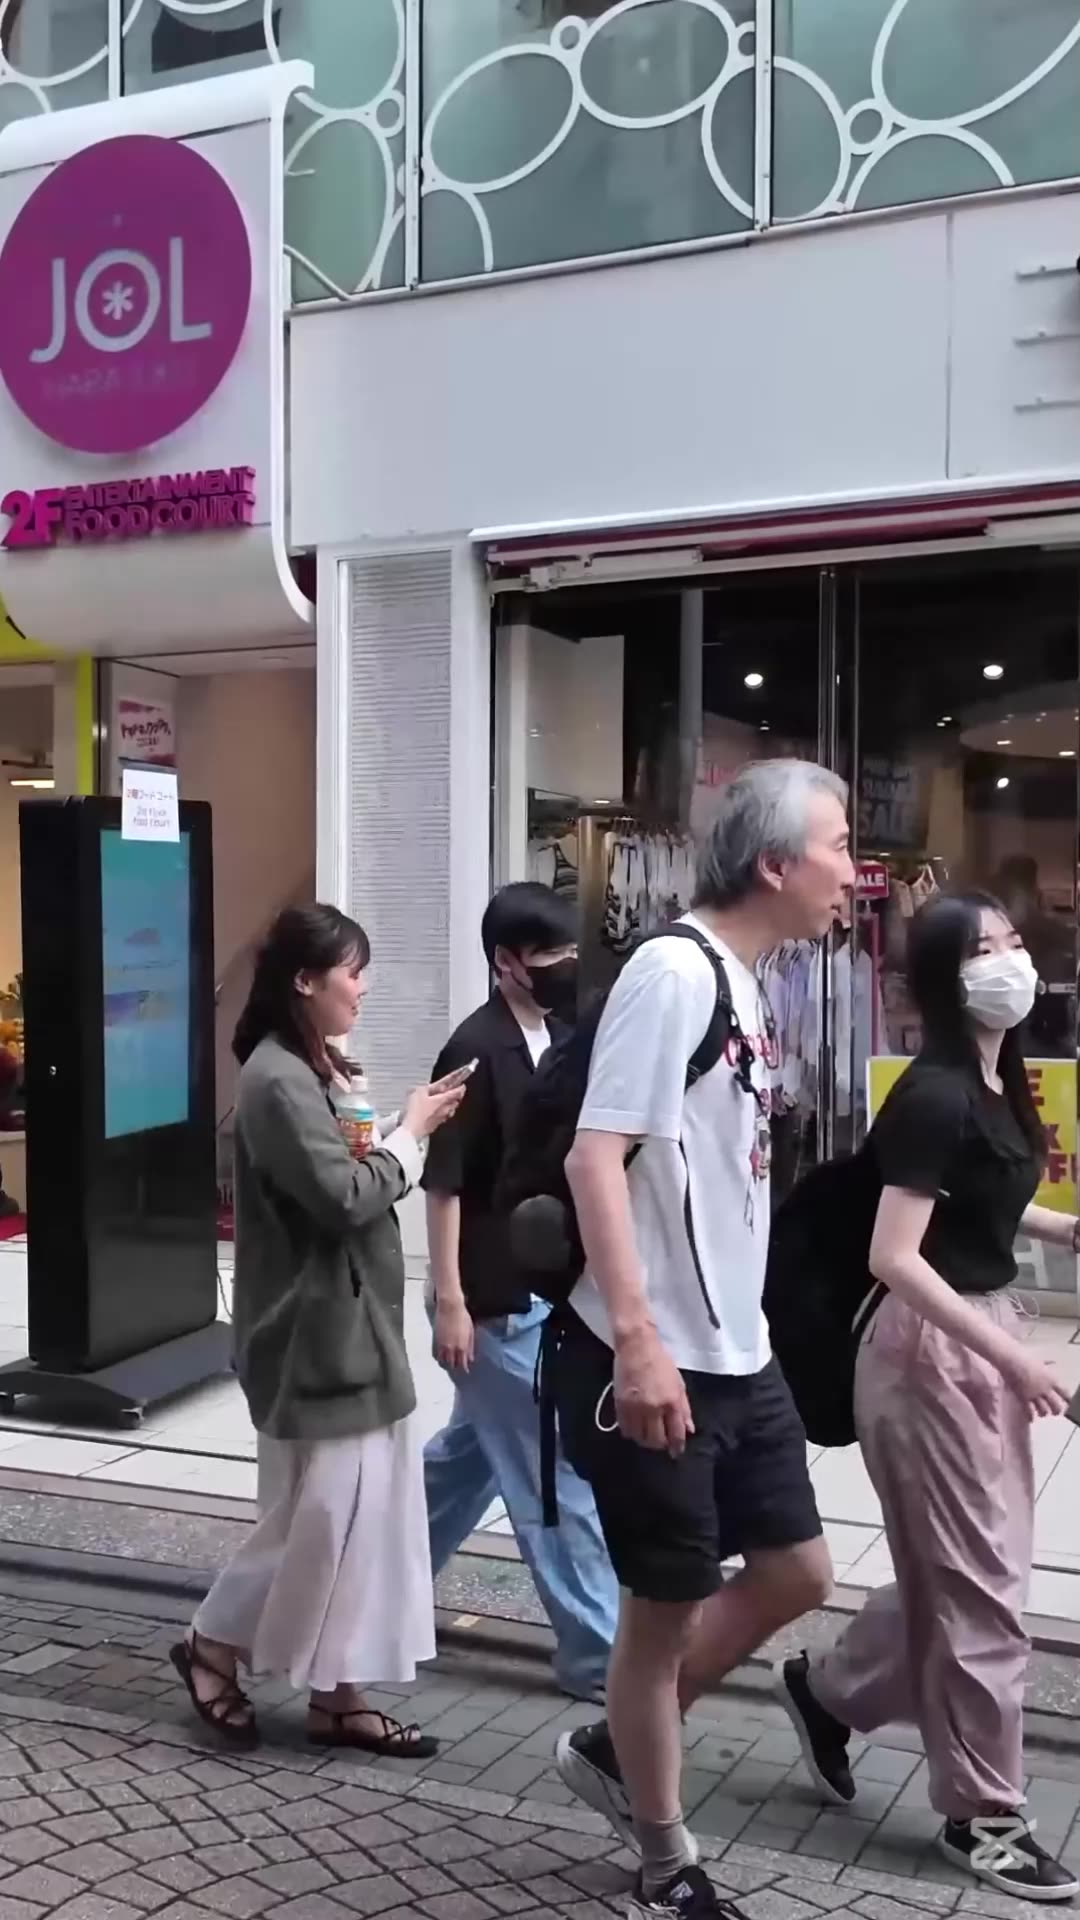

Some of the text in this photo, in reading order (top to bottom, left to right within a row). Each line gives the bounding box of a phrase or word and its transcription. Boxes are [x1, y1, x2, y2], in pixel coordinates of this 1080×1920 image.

[29, 237, 212, 363] JOL
[64, 466, 256, 510] ENTERTAINMENT
[1, 488, 64, 549] 2F
[64, 493, 256, 541] FOOD COURT
[855, 873, 885, 886] ALE
